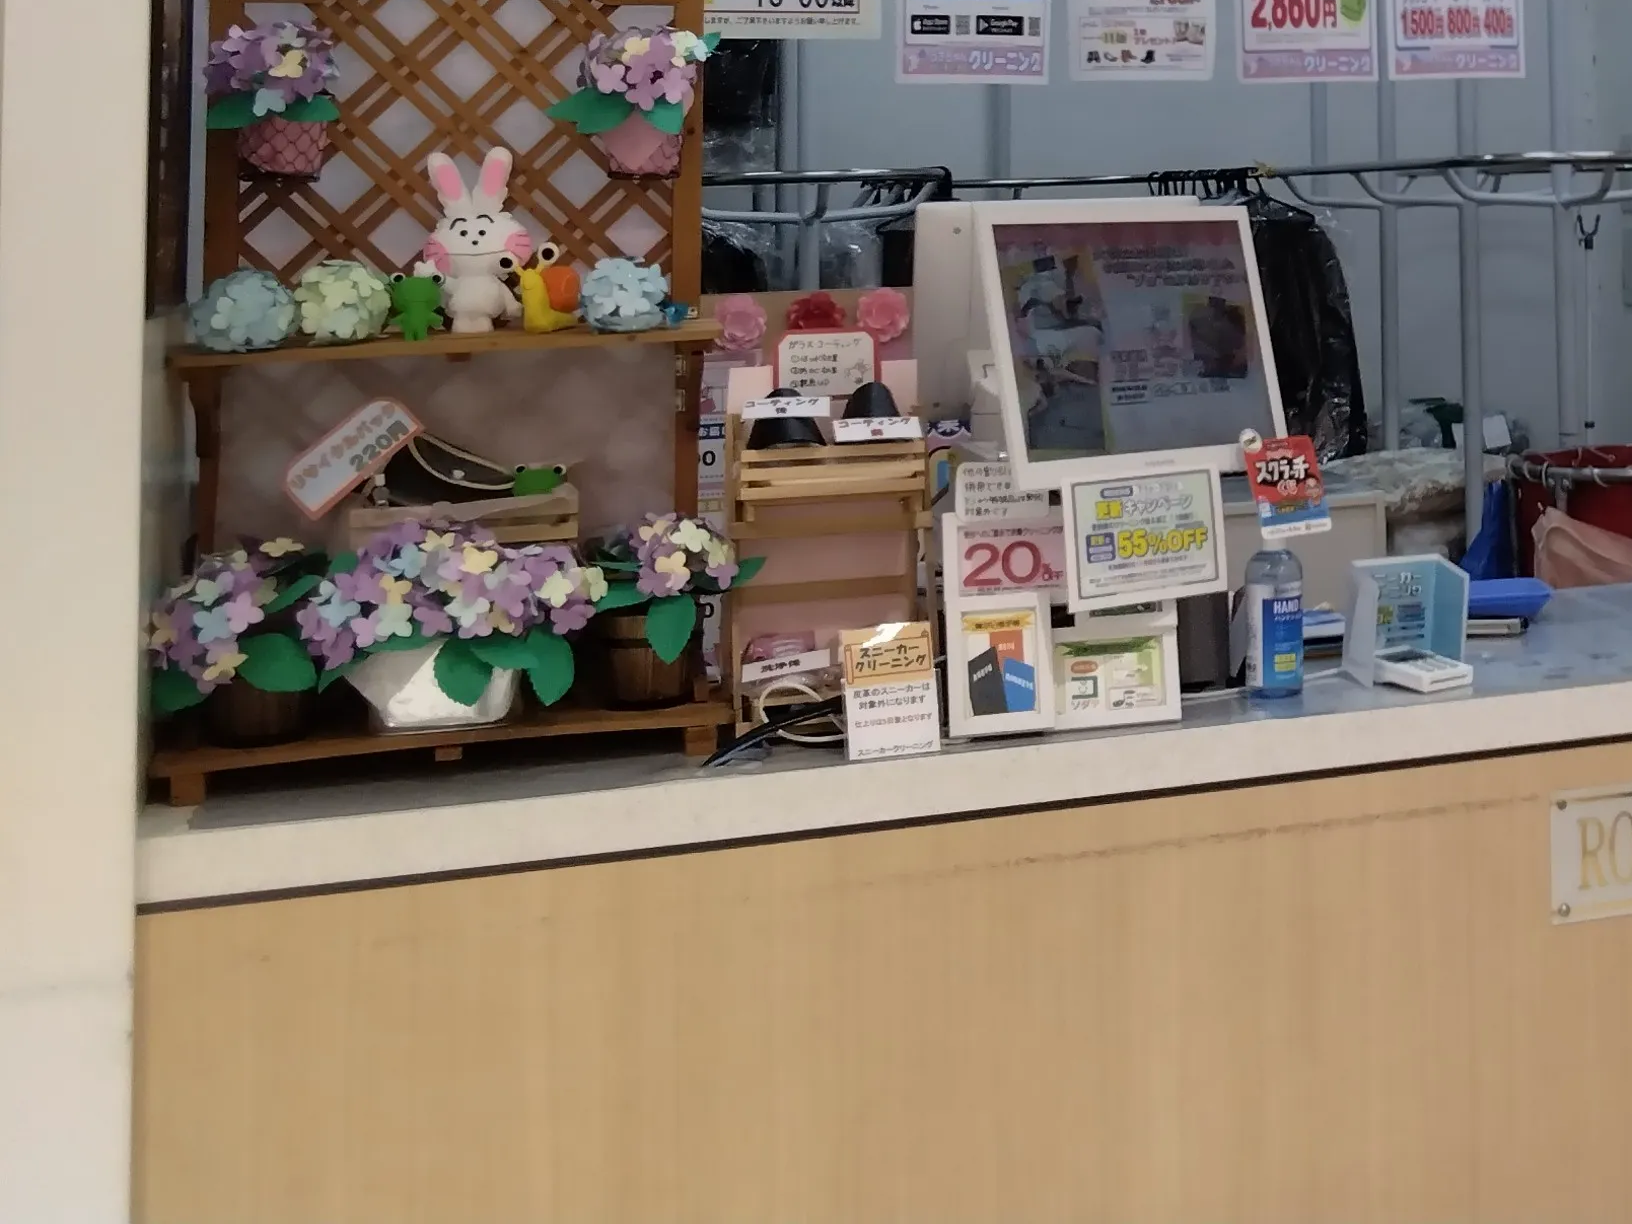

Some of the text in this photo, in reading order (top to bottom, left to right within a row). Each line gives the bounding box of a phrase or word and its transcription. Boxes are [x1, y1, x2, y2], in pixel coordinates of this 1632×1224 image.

[1254, 454, 1310, 484] スクラッチ
[1117, 527, 1209, 560] 55%OFF
[963, 540, 1043, 587] 20
[1273, 598, 1300, 615] HAND
[855, 653, 927, 673] クリーニング
[859, 643, 920, 659] スニーカー
